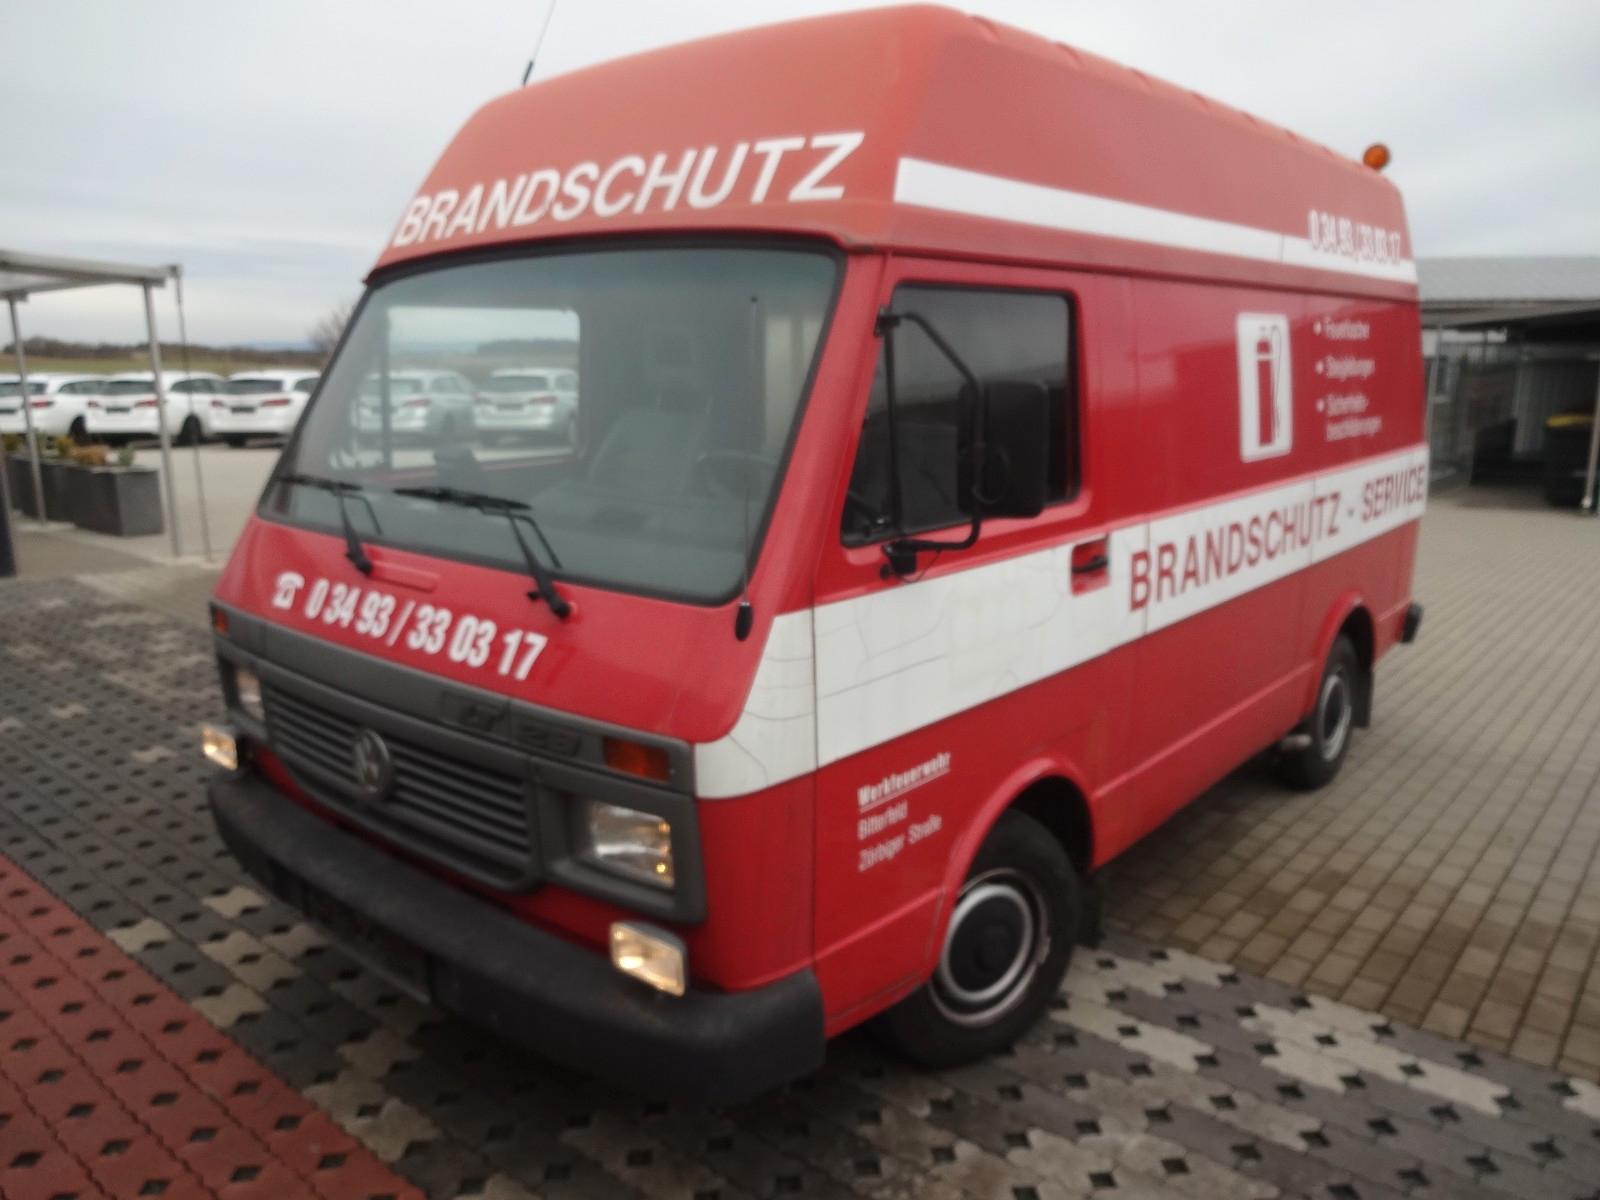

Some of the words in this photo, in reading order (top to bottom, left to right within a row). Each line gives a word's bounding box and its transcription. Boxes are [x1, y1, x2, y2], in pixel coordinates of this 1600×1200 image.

[393, 131, 865, 248] BRANDSCHUTZ
[1129, 492, 1341, 613] BRANDSCHUTZ
[1361, 464, 1426, 523] SERVICE
[304, 577, 330, 620] 0
[322, 582, 361, 628] 34
[355, 591, 396, 639] 93
[386, 600, 416, 647] /
[407, 603, 453, 655] 33
[449, 614, 497, 668] 03
[497, 628, 549, 681] 17
